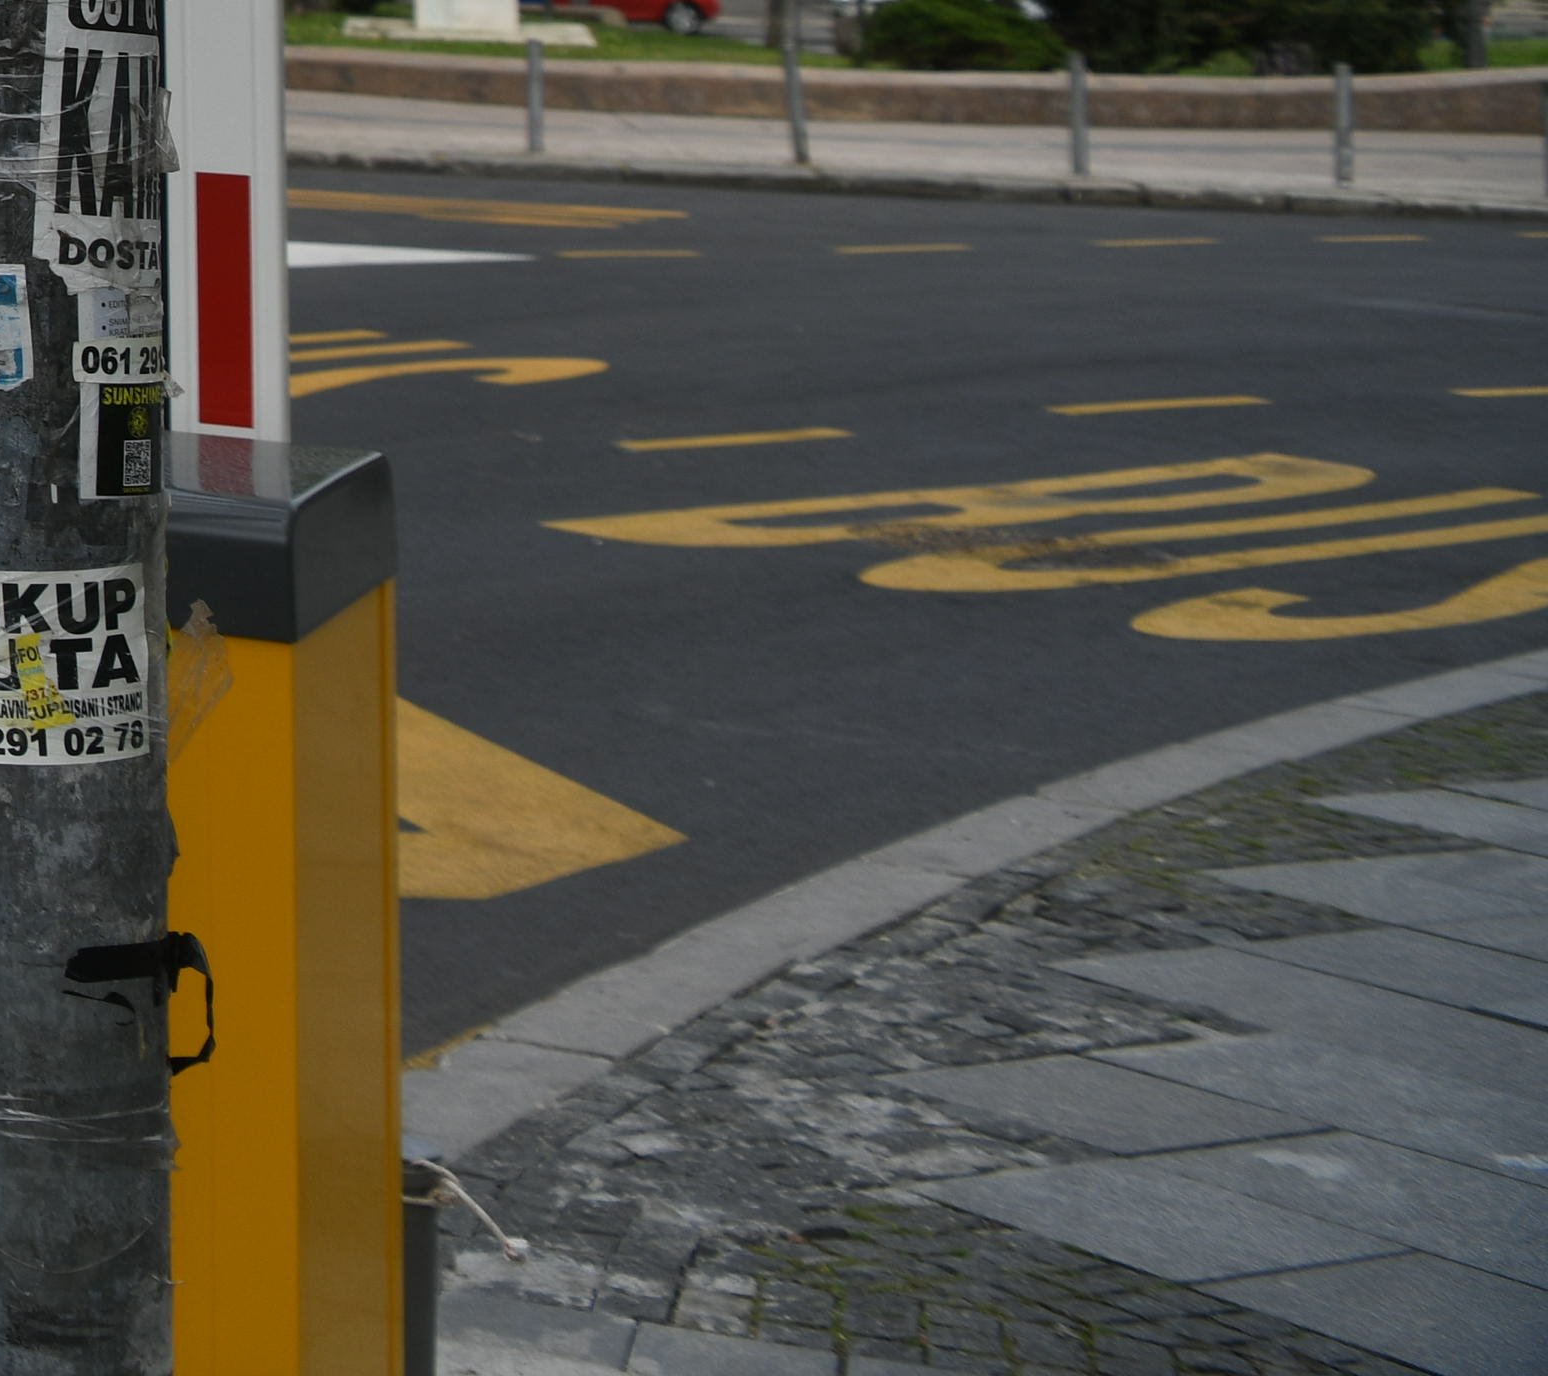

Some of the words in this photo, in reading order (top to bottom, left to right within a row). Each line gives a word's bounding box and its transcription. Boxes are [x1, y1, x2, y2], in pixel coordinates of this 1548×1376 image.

[58, 237, 159, 270] DOSTA
[81, 346, 130, 375] 061
[64, 726, 105, 757] 02
[114, 720, 144, 752] 78
